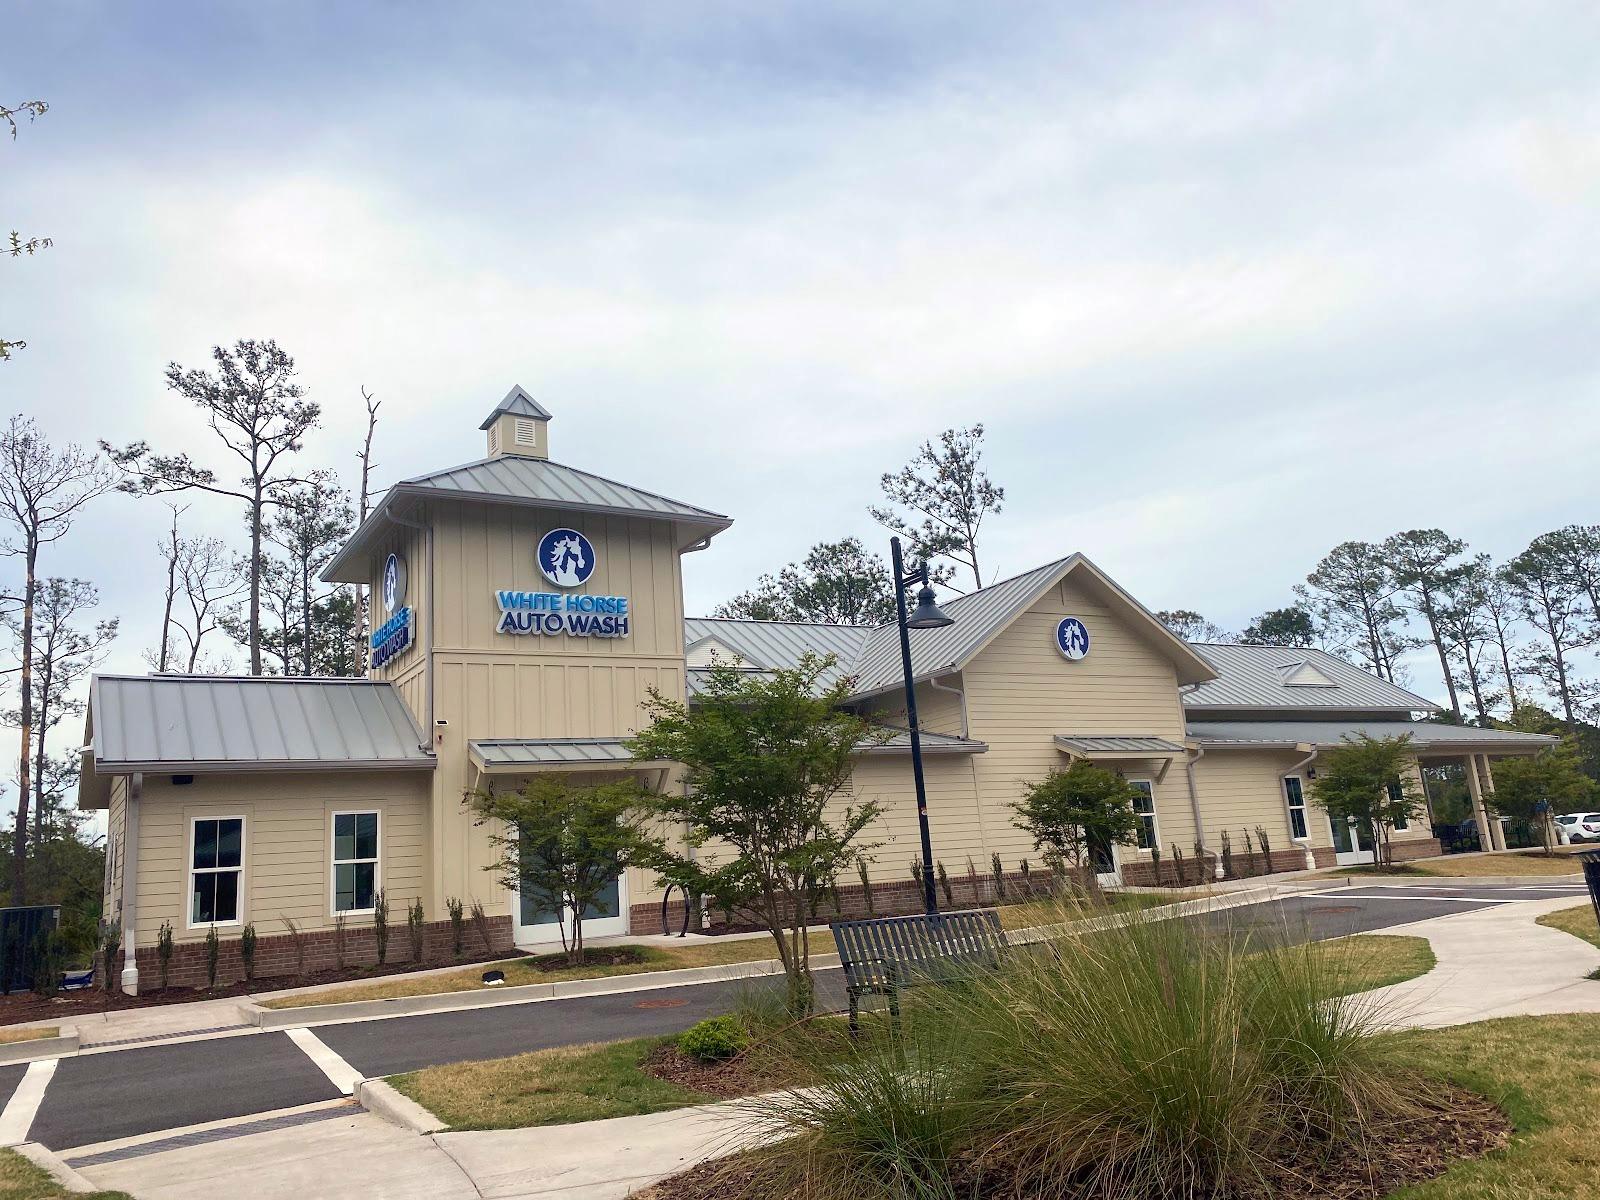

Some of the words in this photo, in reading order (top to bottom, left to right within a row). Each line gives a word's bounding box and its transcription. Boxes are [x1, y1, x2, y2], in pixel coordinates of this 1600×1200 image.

[499, 591, 563, 611] WHITE
[565, 595, 628, 615] HORSE
[501, 611, 564, 632] AUTO
[566, 614, 629, 635] WASH
